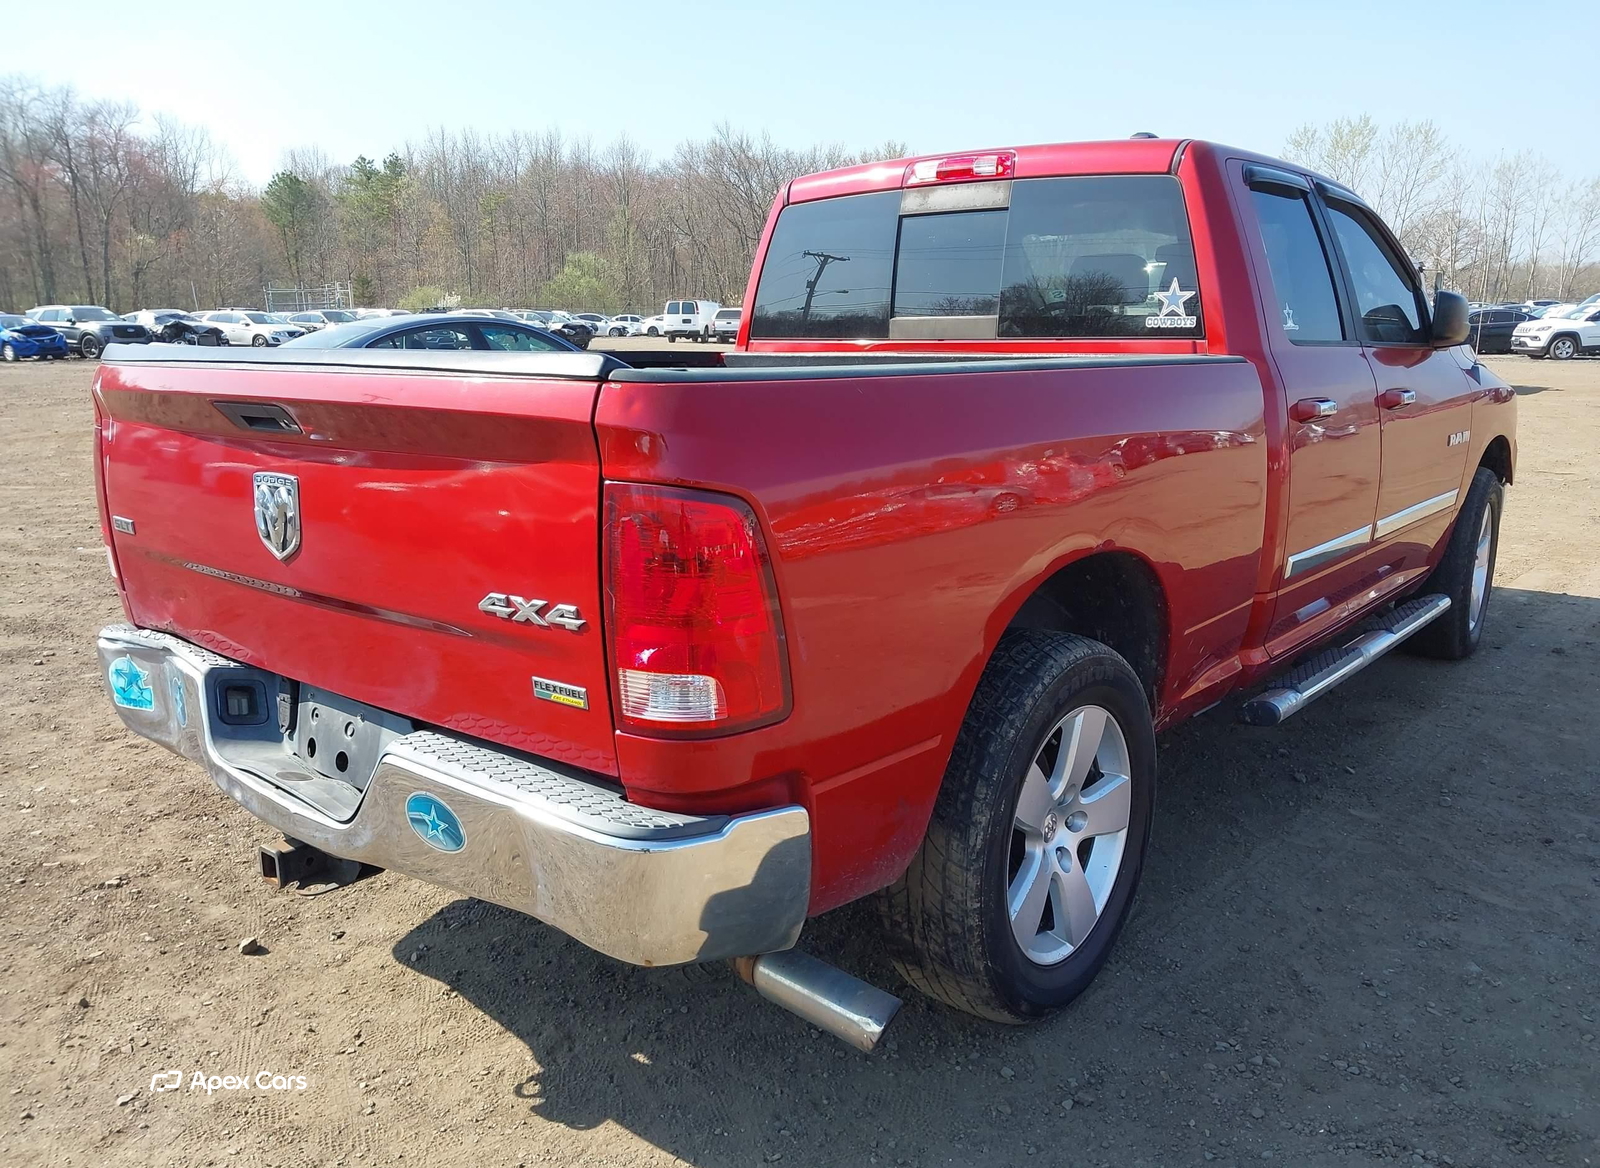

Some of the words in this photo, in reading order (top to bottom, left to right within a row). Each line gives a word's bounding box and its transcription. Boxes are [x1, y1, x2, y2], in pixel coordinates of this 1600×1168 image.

[1146, 317, 1196, 327] COWBOYS
[1448, 430, 1470, 446] RAM
[255, 475, 292, 486] DODGE
[114, 519, 132, 532] SLT
[533, 680, 584, 700] FLEXFUEL
[1057, 665, 1115, 704] SAILUN
